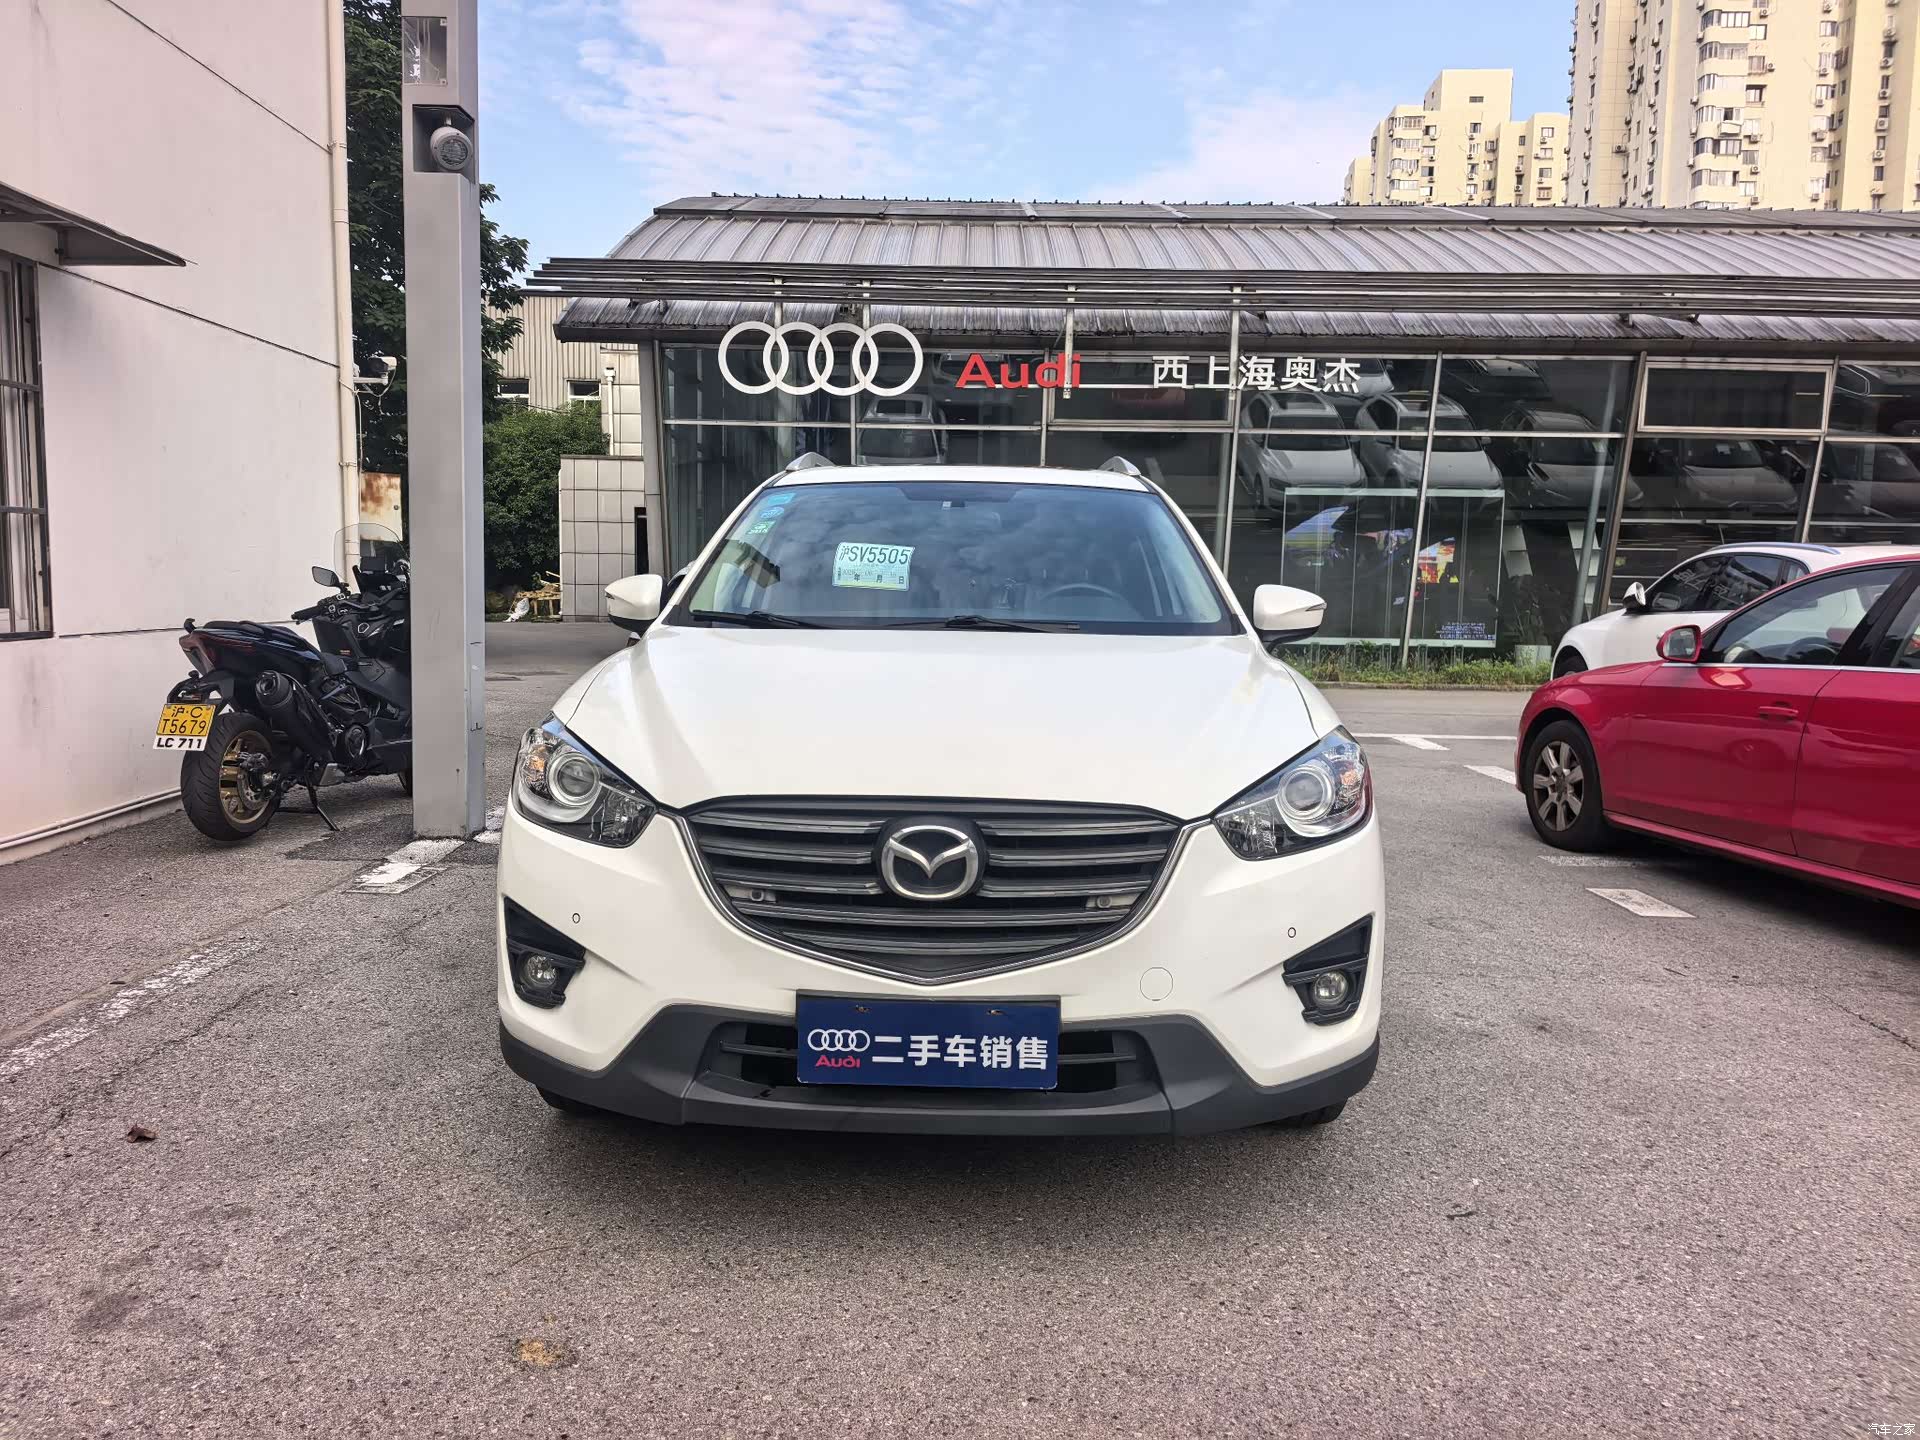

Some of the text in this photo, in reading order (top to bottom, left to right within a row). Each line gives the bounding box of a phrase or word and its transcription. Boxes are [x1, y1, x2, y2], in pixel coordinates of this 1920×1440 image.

[955, 352, 1081, 388] Audi
[1152, 355, 1361, 393] 西上海奥杰
[839, 545, 910, 565] 沪SV5505
[162, 718, 207, 734] T5679
[156, 737, 202, 749] LC 711
[815, 1054, 861, 1069] Audi
[871, 1034, 1049, 1070] 二手车销售
